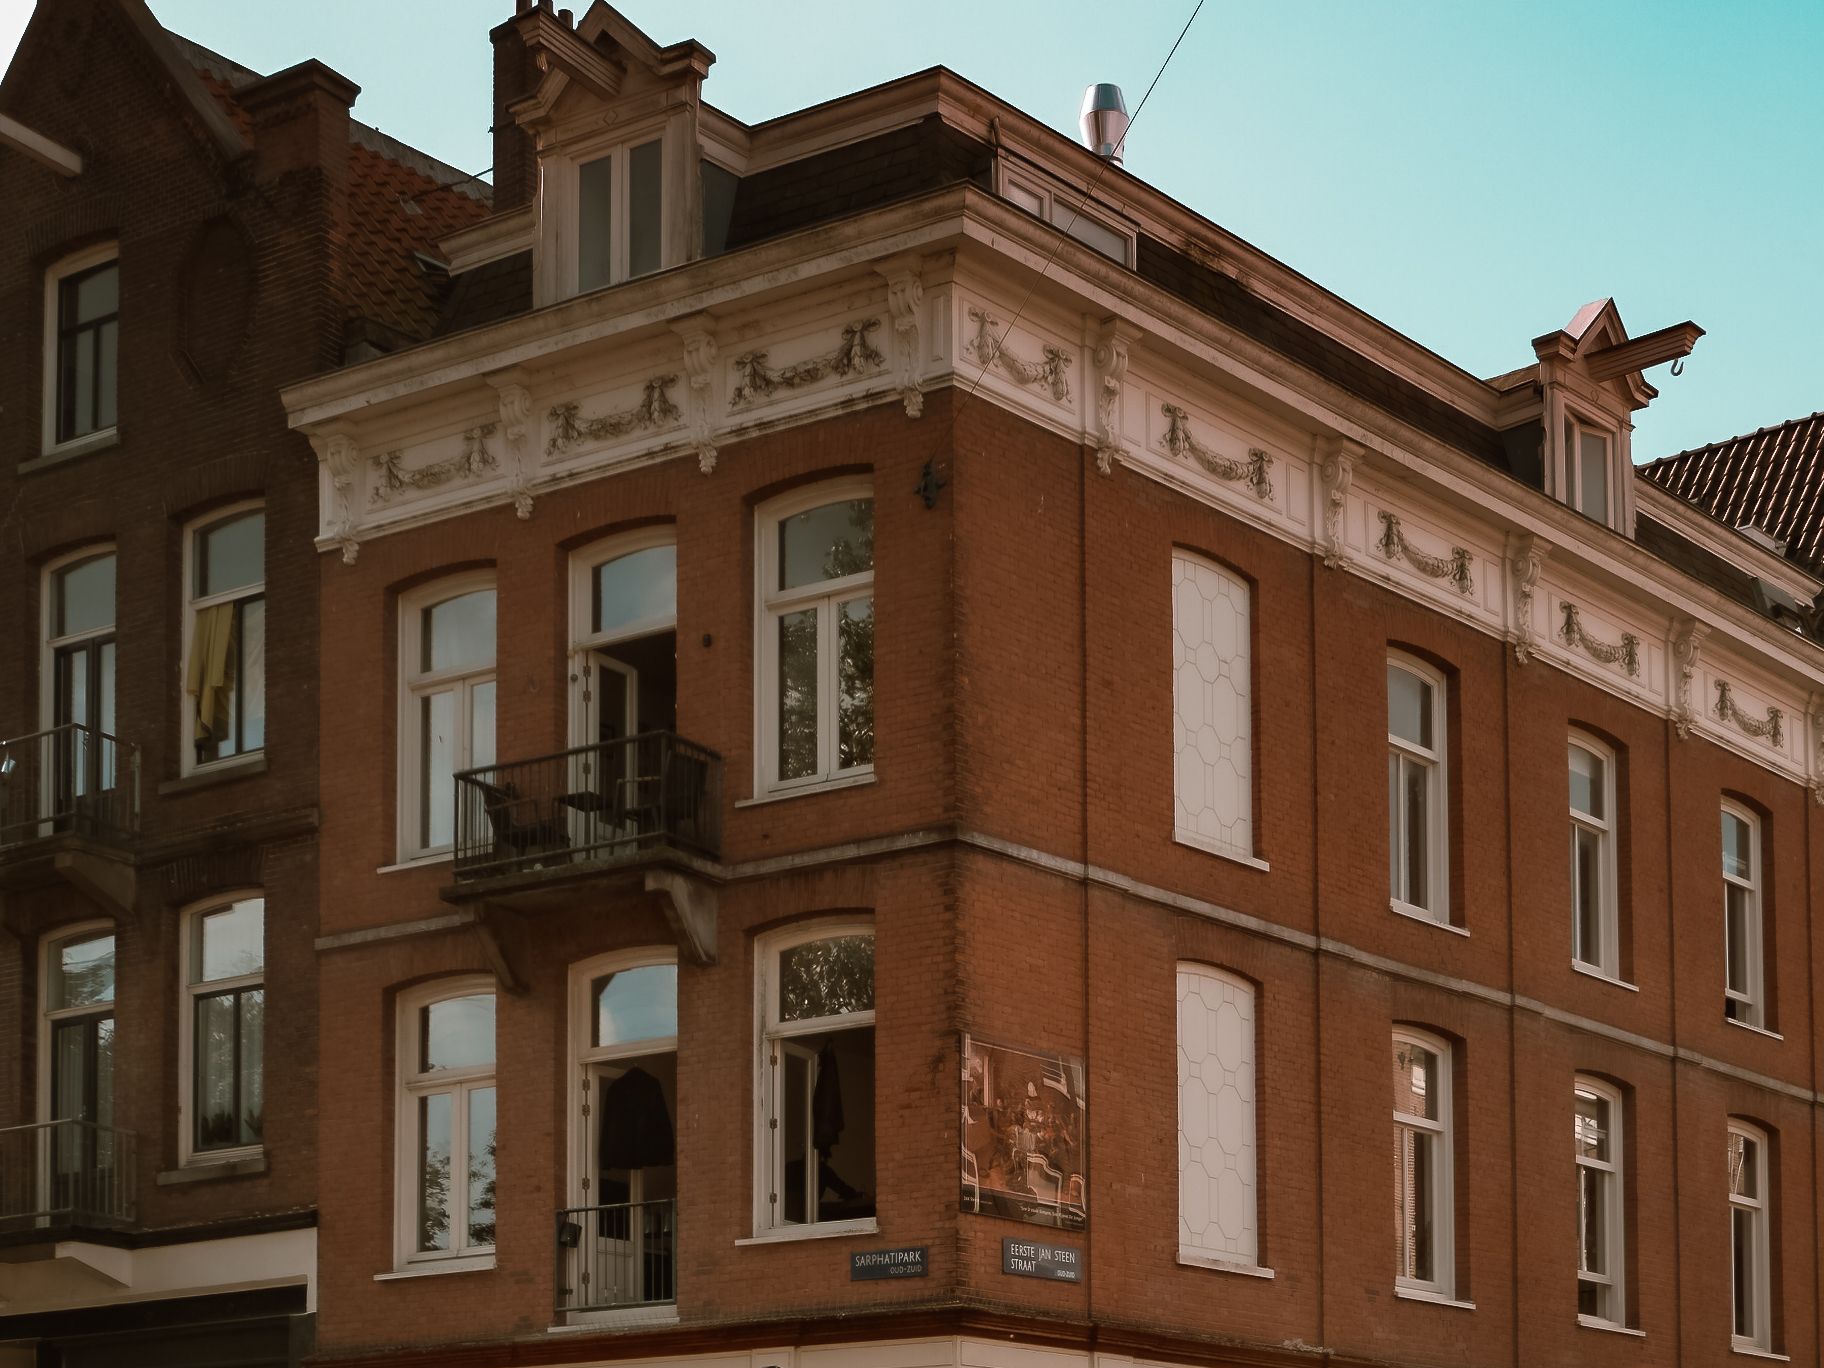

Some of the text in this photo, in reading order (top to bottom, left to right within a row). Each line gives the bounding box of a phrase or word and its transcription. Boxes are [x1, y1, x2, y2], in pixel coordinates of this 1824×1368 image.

[855, 1250, 922, 1267] SARPHATIPARK
[1010, 1243, 1076, 1264] EERSTE JAN STEEN
[890, 1264, 923, 1275] OUD-ZUID
[1010, 1258, 1036, 1273] STRAAT
